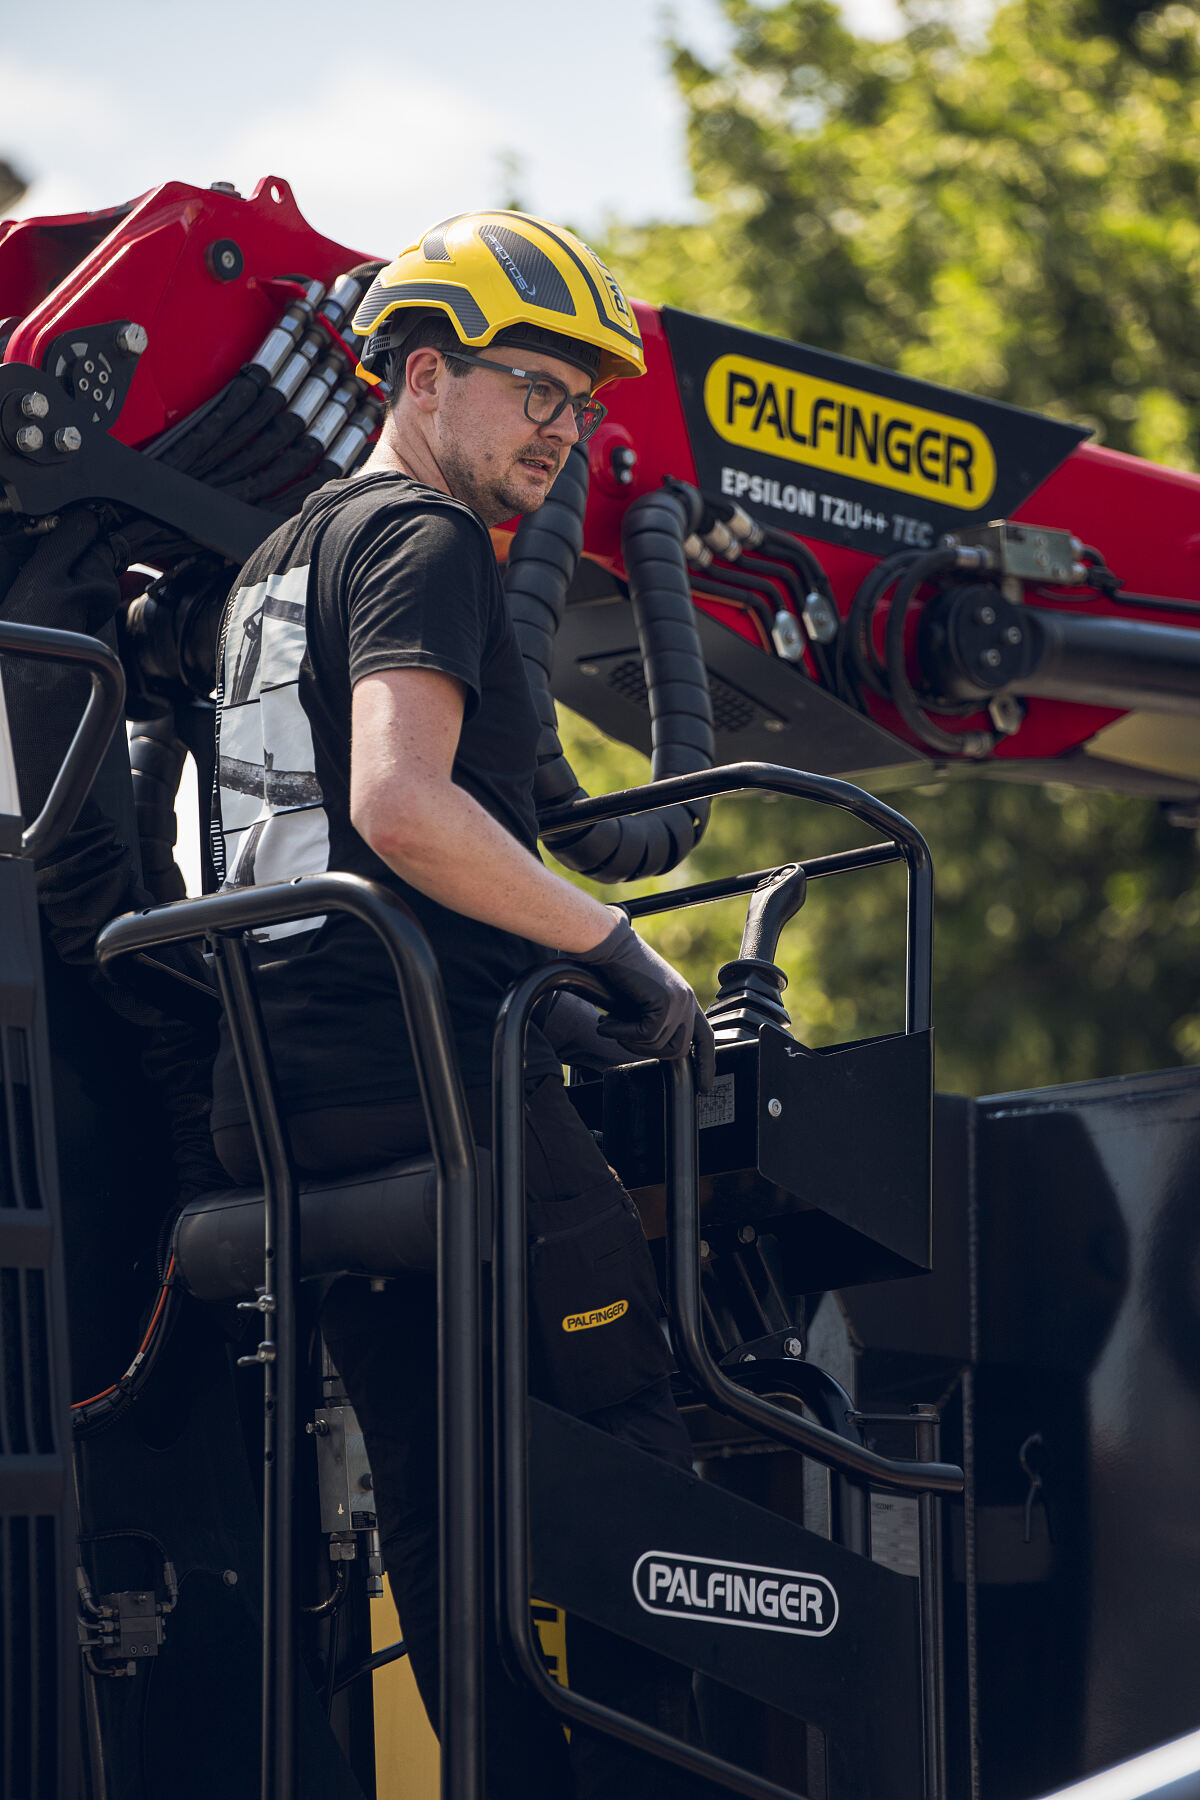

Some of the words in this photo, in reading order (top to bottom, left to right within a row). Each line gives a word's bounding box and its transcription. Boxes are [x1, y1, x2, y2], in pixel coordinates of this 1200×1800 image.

[484, 233, 529, 291] PROTOS
[725, 370, 976, 493] PALFINGER
[720, 466, 817, 518] EPSILON
[819, 494, 889, 534] TZU++
[892, 513, 934, 549] TEC
[566, 1302, 625, 1329] PALFINGER
[649, 1562, 823, 1625] PALFINGER
